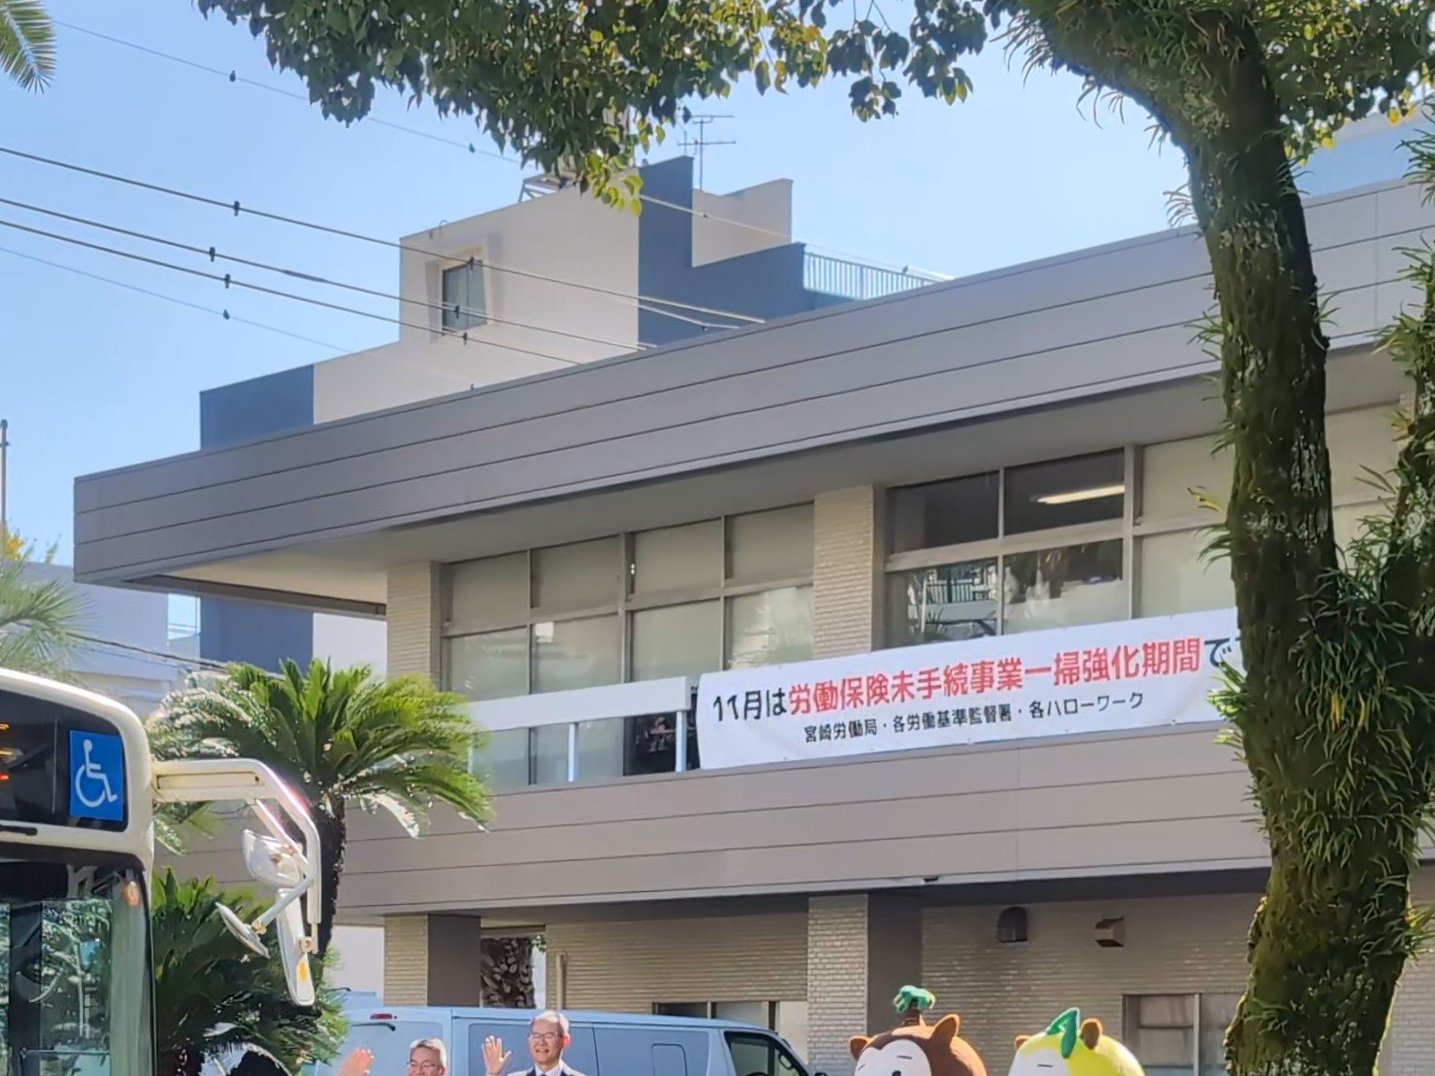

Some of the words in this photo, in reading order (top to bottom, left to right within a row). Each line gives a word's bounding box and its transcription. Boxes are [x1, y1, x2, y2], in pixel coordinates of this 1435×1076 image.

[714, 636, 1242, 722] 11月は労働保険未手続事業一掃強化期間で
